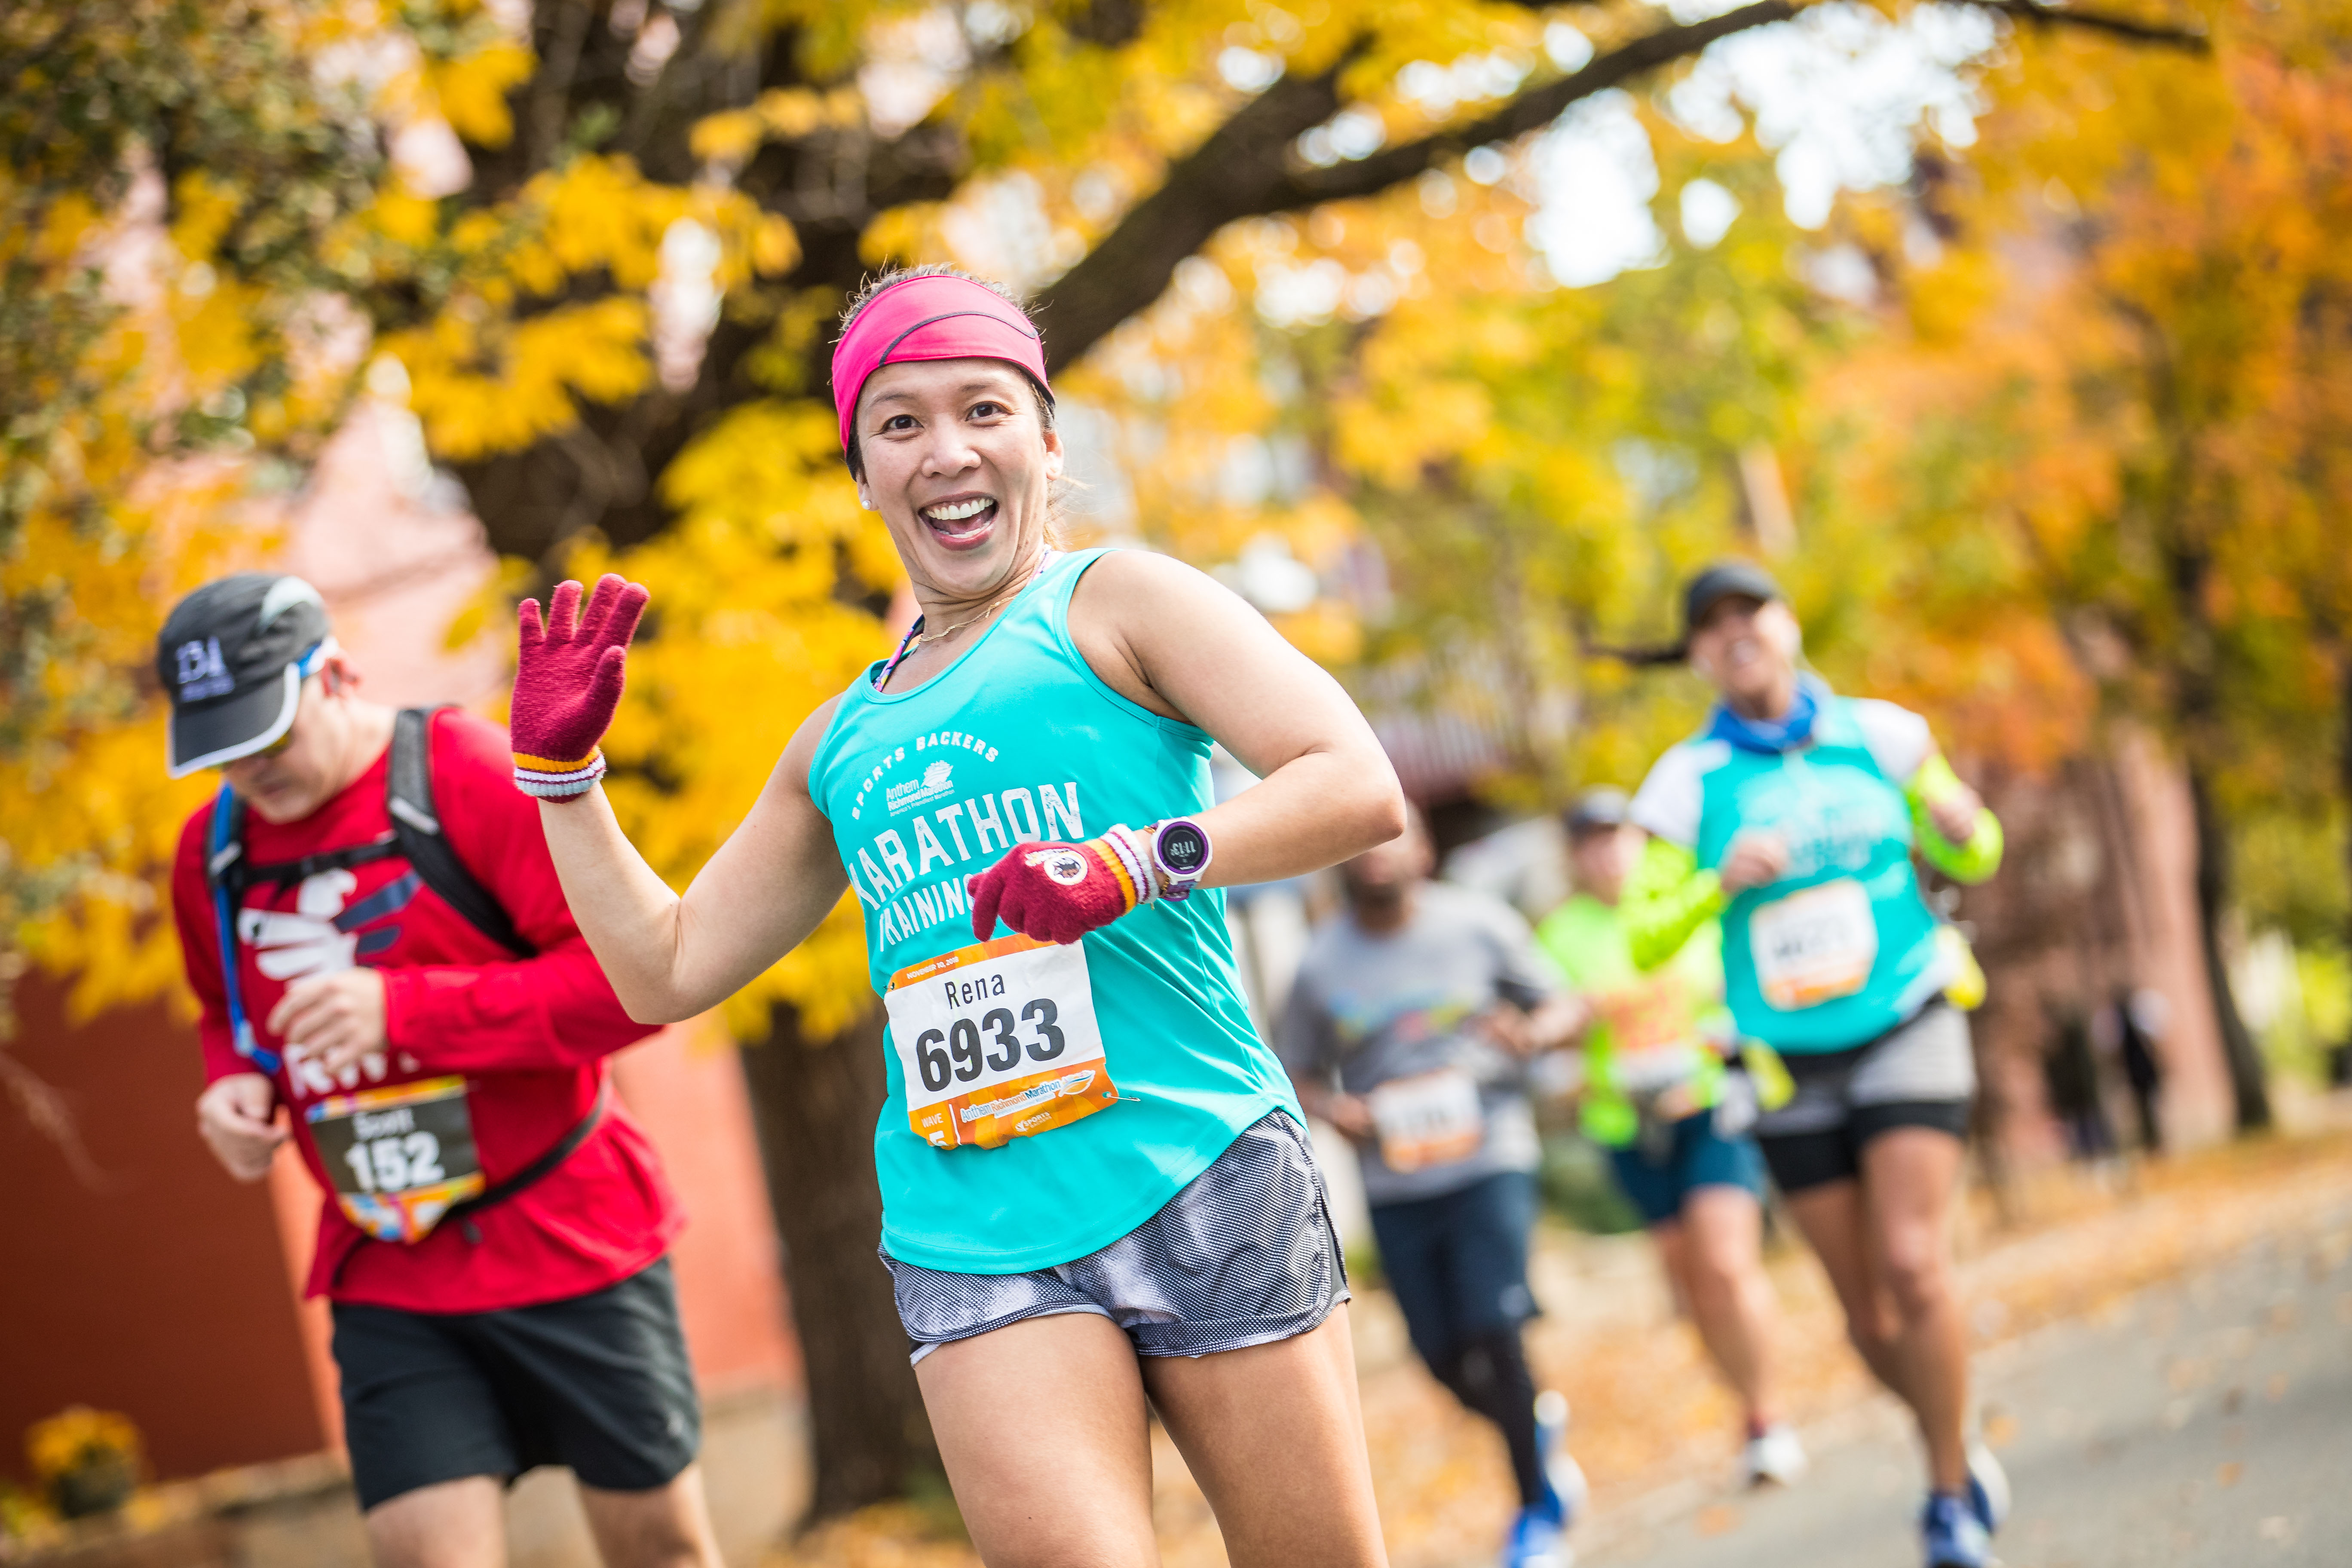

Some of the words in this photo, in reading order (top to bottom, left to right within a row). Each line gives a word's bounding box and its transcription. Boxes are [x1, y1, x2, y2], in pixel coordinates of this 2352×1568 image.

[852, 747, 905, 820] SPORTS
[916, 731, 999, 763] BACKERS
[886, 779, 920, 802] Anthem
[944, 974, 1005, 1010] Rena
[916, 998, 1065, 1092] 6933
[921, 1112, 944, 1128] WAVE
[961, 1102, 992, 1122] Anthem
[991, 1093, 1027, 1112] Richmond
[1024, 1080, 1061, 1100] Marathon
[1024, 1112, 1050, 1127] SPORTS
[344, 1130, 446, 1194] 152
